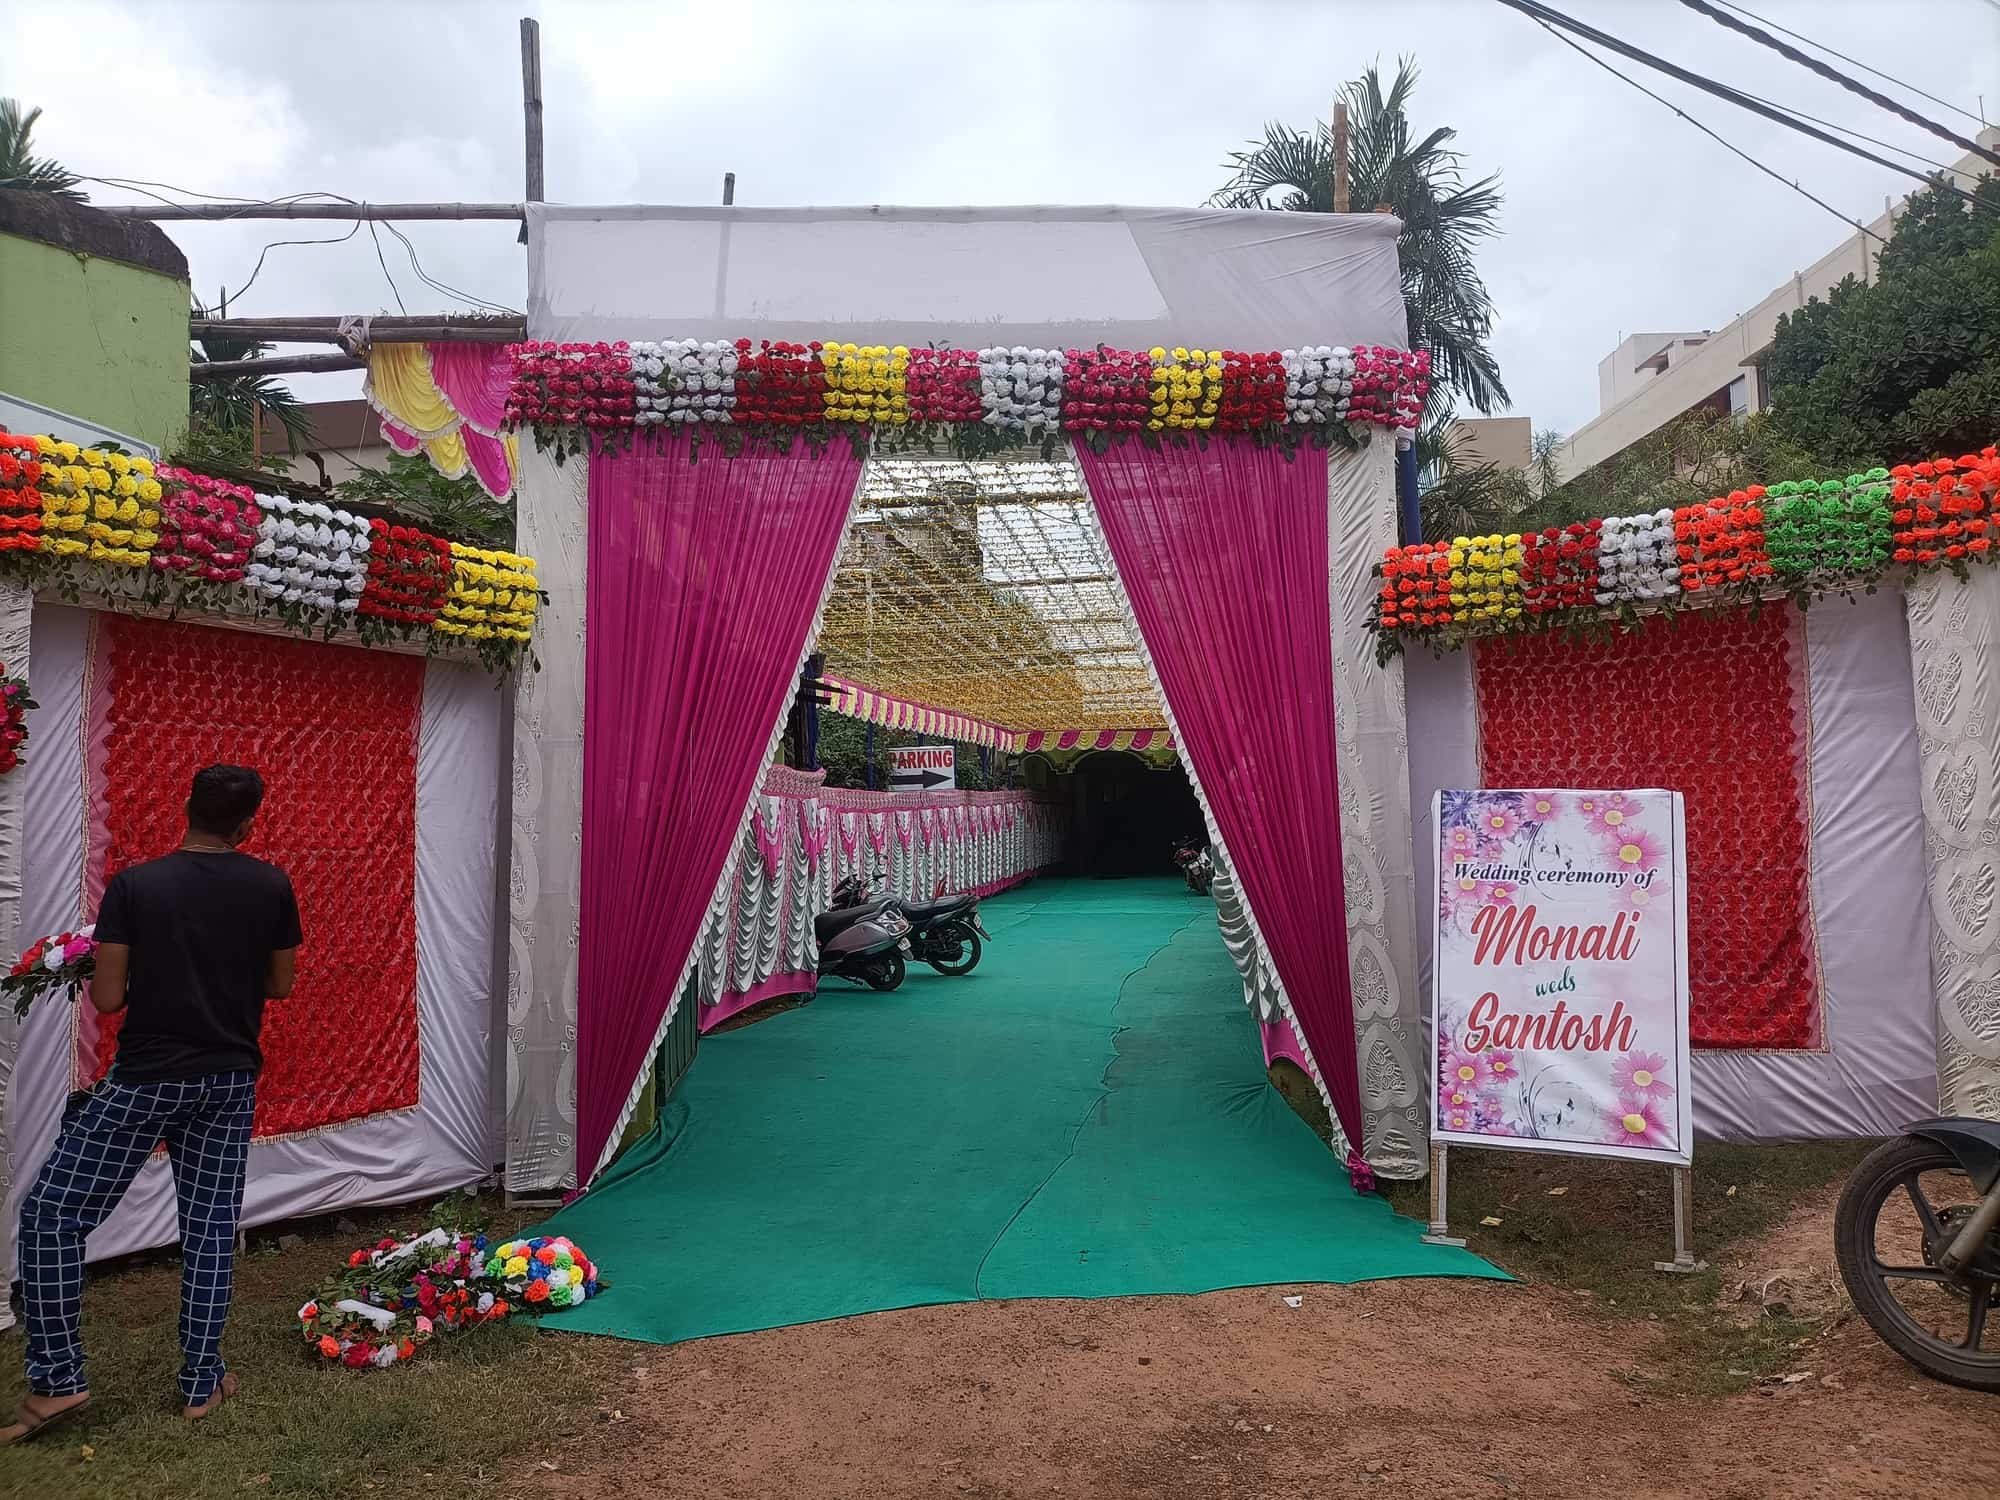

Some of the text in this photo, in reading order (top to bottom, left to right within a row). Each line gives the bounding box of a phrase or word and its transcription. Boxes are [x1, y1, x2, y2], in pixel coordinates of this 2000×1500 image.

[1454, 862, 1658, 889] Wedding ceremony of
[1470, 904, 1640, 966] Monali
[1535, 966, 1576, 997] weds
[1464, 992, 1638, 1054] Santosh
